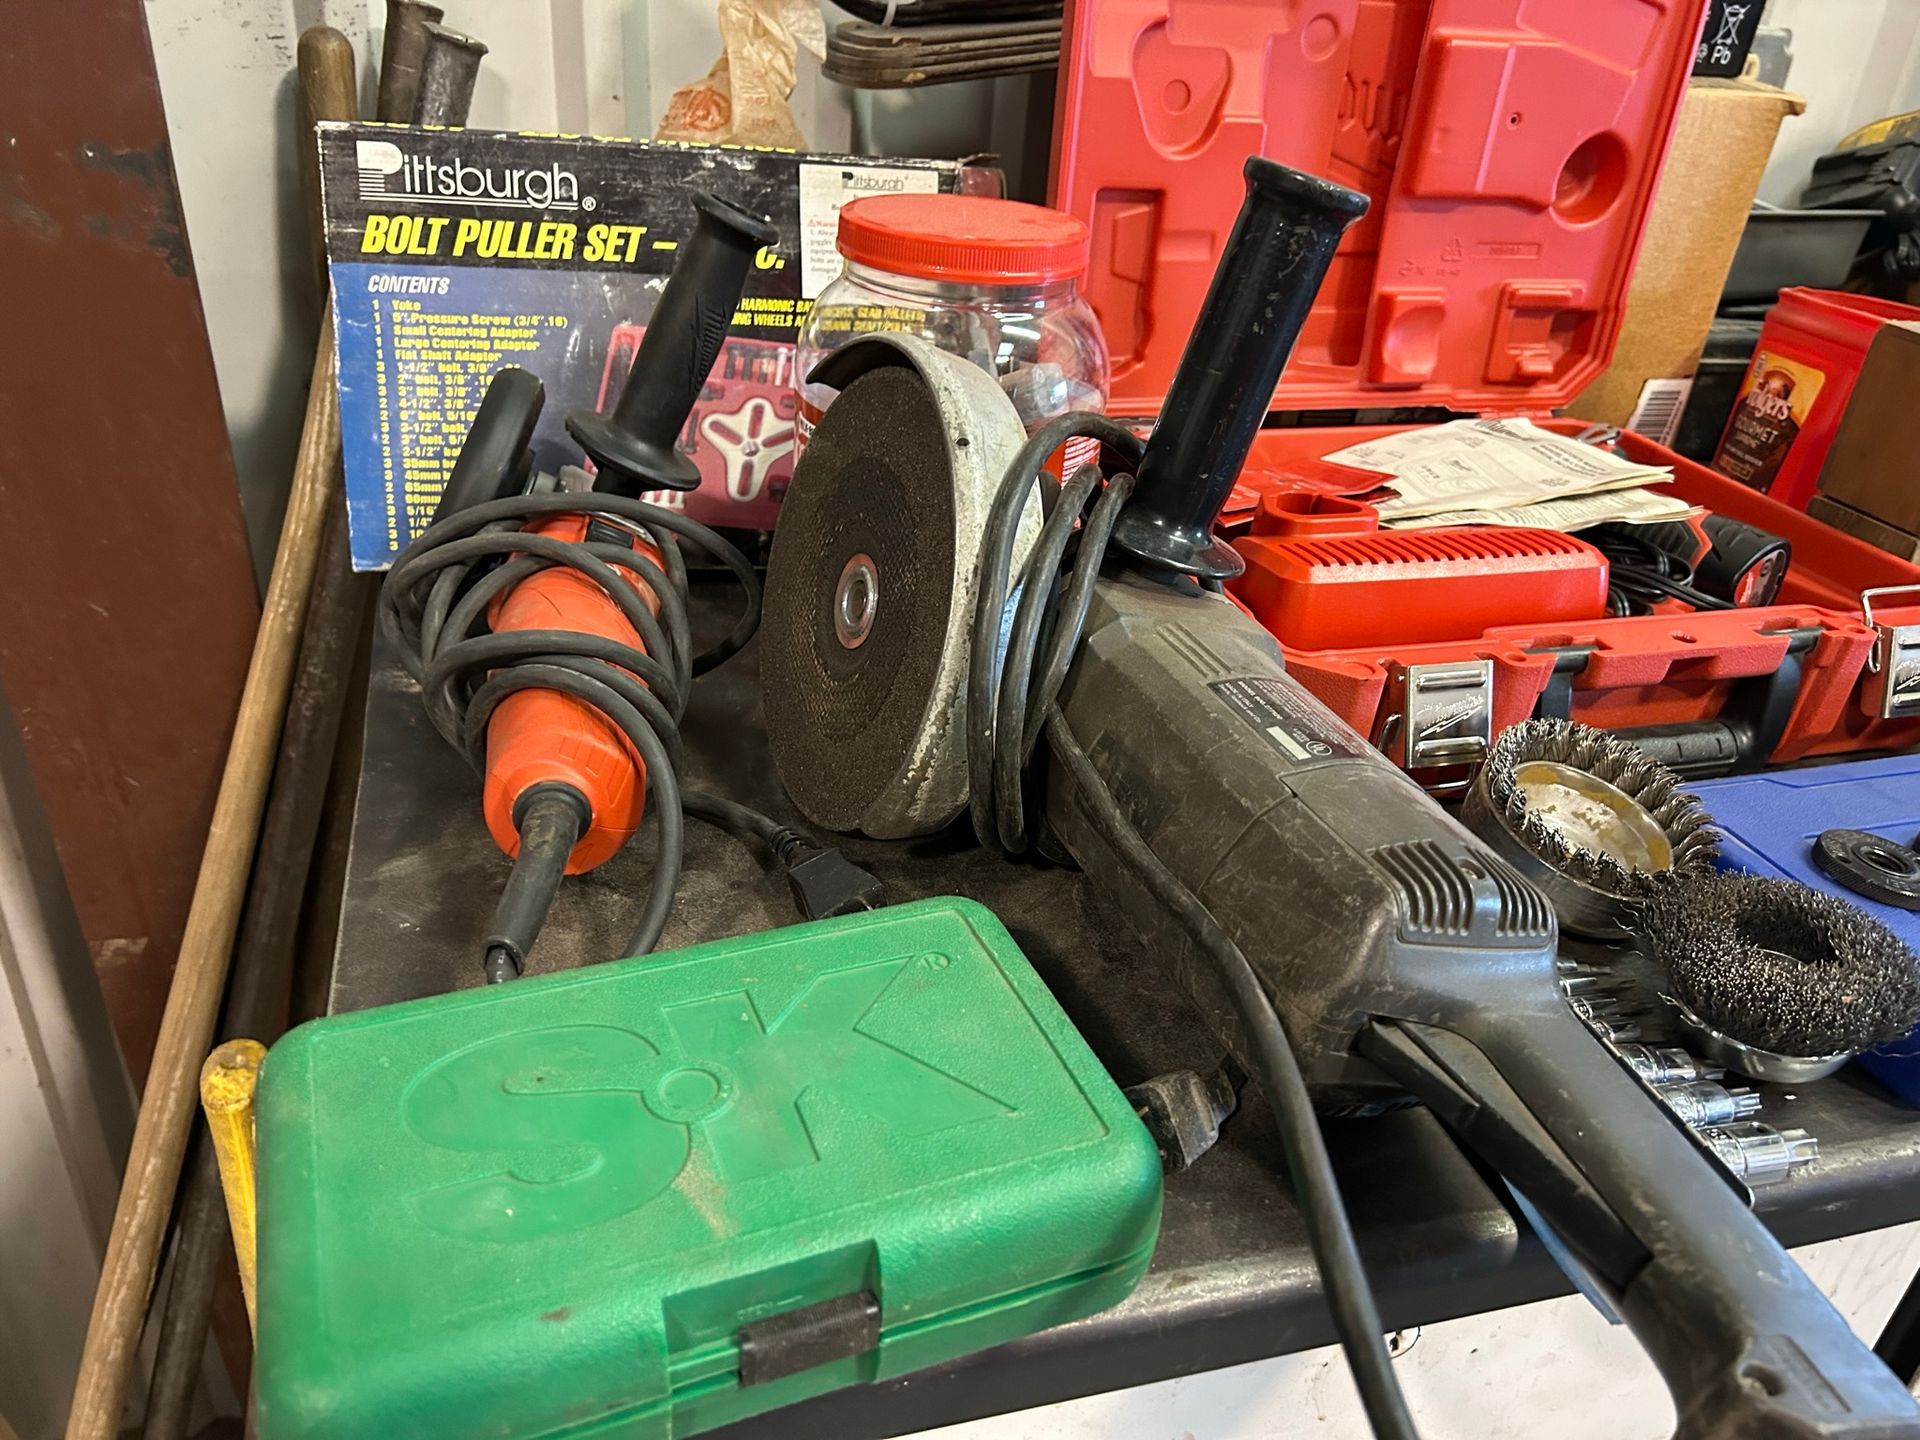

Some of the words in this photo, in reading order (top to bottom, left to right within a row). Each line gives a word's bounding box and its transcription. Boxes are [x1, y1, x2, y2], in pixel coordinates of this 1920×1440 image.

[1711, 45, 1731, 64] Pb
[356, 140, 579, 210] Pittsburgh
[842, 171, 904, 191] Pittsburgh
[361, 215, 450, 256] BOLT
[452, 218, 578, 260] PULLER
[583, 224, 647, 263] SET
[368, 275, 450, 295] CONTENTS
[372, 300, 379, 310] 1
[392, 300, 421, 311] Yoke
[741, 298, 795, 313] HARMONIC
[373, 312, 380, 322] 1
[410, 313, 469, 325] Pressure
[471, 314, 511, 325] Screw
[754, 314, 793, 327] WHEELS
[375, 324, 381, 334] 1
[393, 325, 426, 335] Small
[429, 325, 487, 338] Centering
[375, 337, 382, 347] 1
[394, 338, 429, 349] Large
[432, 338, 490, 350] Centering
[376, 349, 383, 359] 1
[421, 351, 451, 361] Shaft
[376, 361, 385, 372] 3
[376, 373, 386, 385] 3
[378, 385, 387, 397] 3
[379, 398, 387, 408] 2
[379, 410, 388, 421] 2
[380, 422, 389, 433] 3
[381, 434, 390, 445] 2
[382, 446, 391, 457] 2
[383, 457, 392, 469] 3
[384, 470, 393, 480] 3
[385, 482, 394, 492] 2
[386, 493, 394, 504] 2
[386, 505, 396, 516] 3
[387, 517, 396, 528] 2
[388, 528, 398, 540] 3
[389, 540, 399, 551] 3
